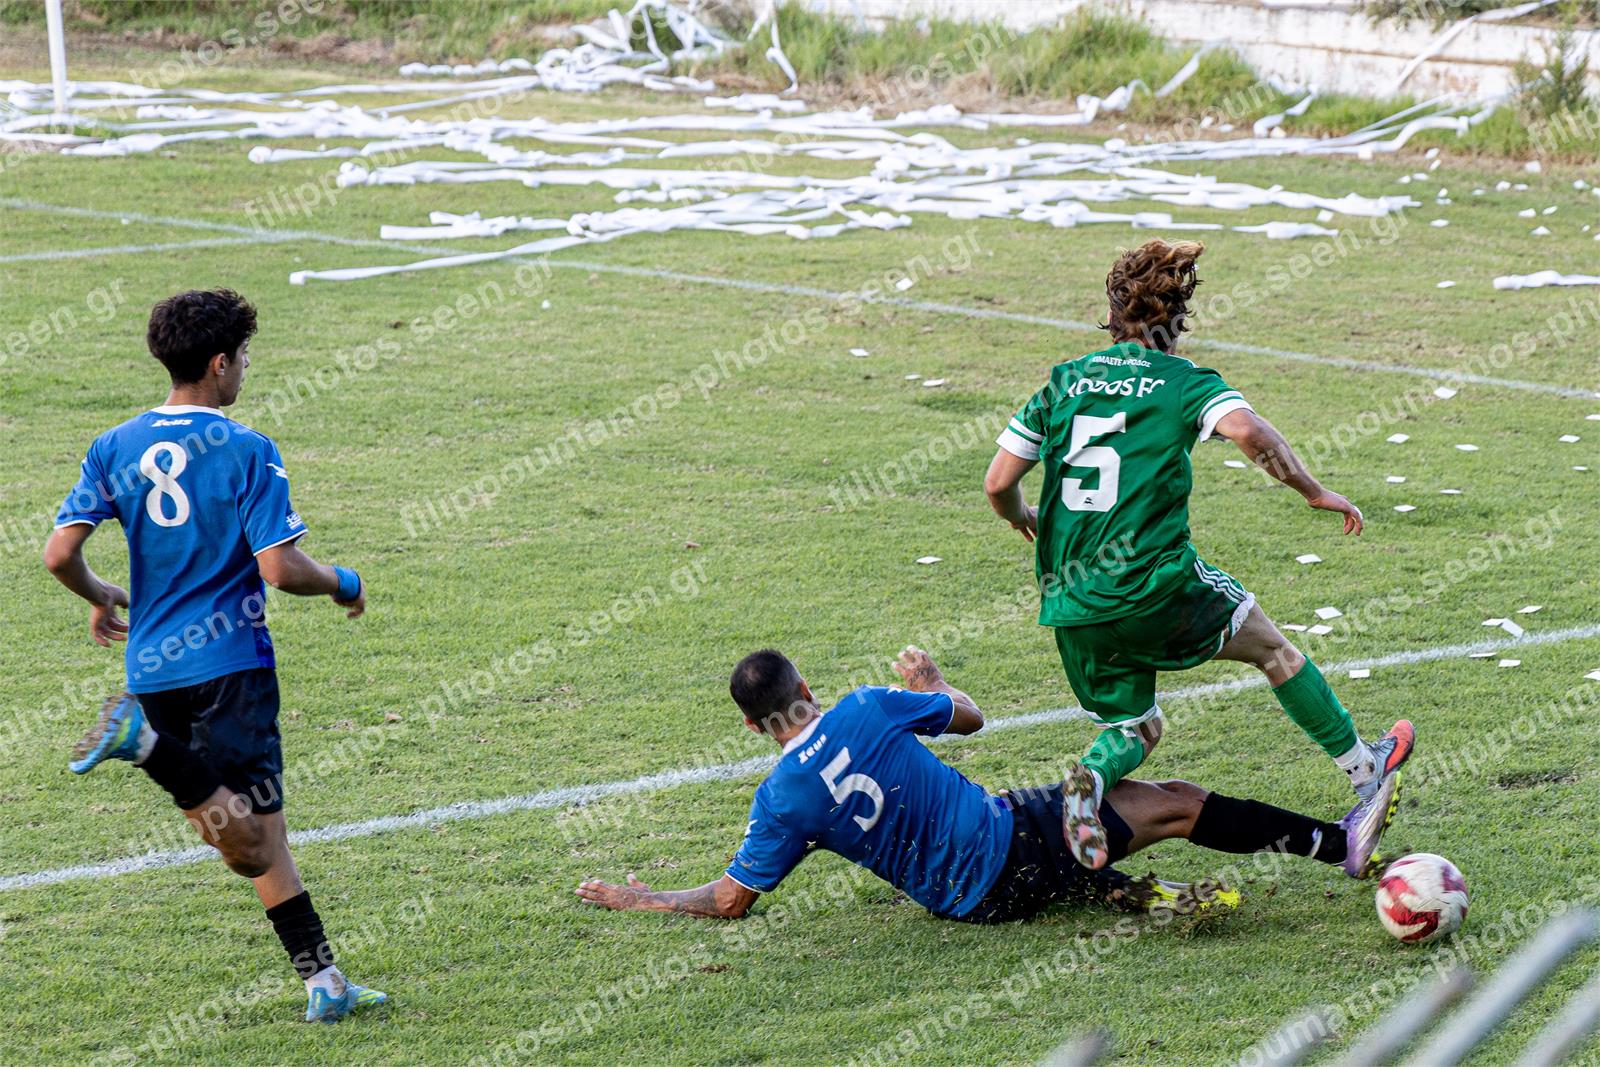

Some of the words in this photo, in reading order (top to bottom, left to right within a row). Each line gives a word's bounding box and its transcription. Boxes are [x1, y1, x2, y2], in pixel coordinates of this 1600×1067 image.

[140, 441, 190, 527] 8
[1061, 411, 1126, 512] 5
[819, 746, 884, 832] 5
